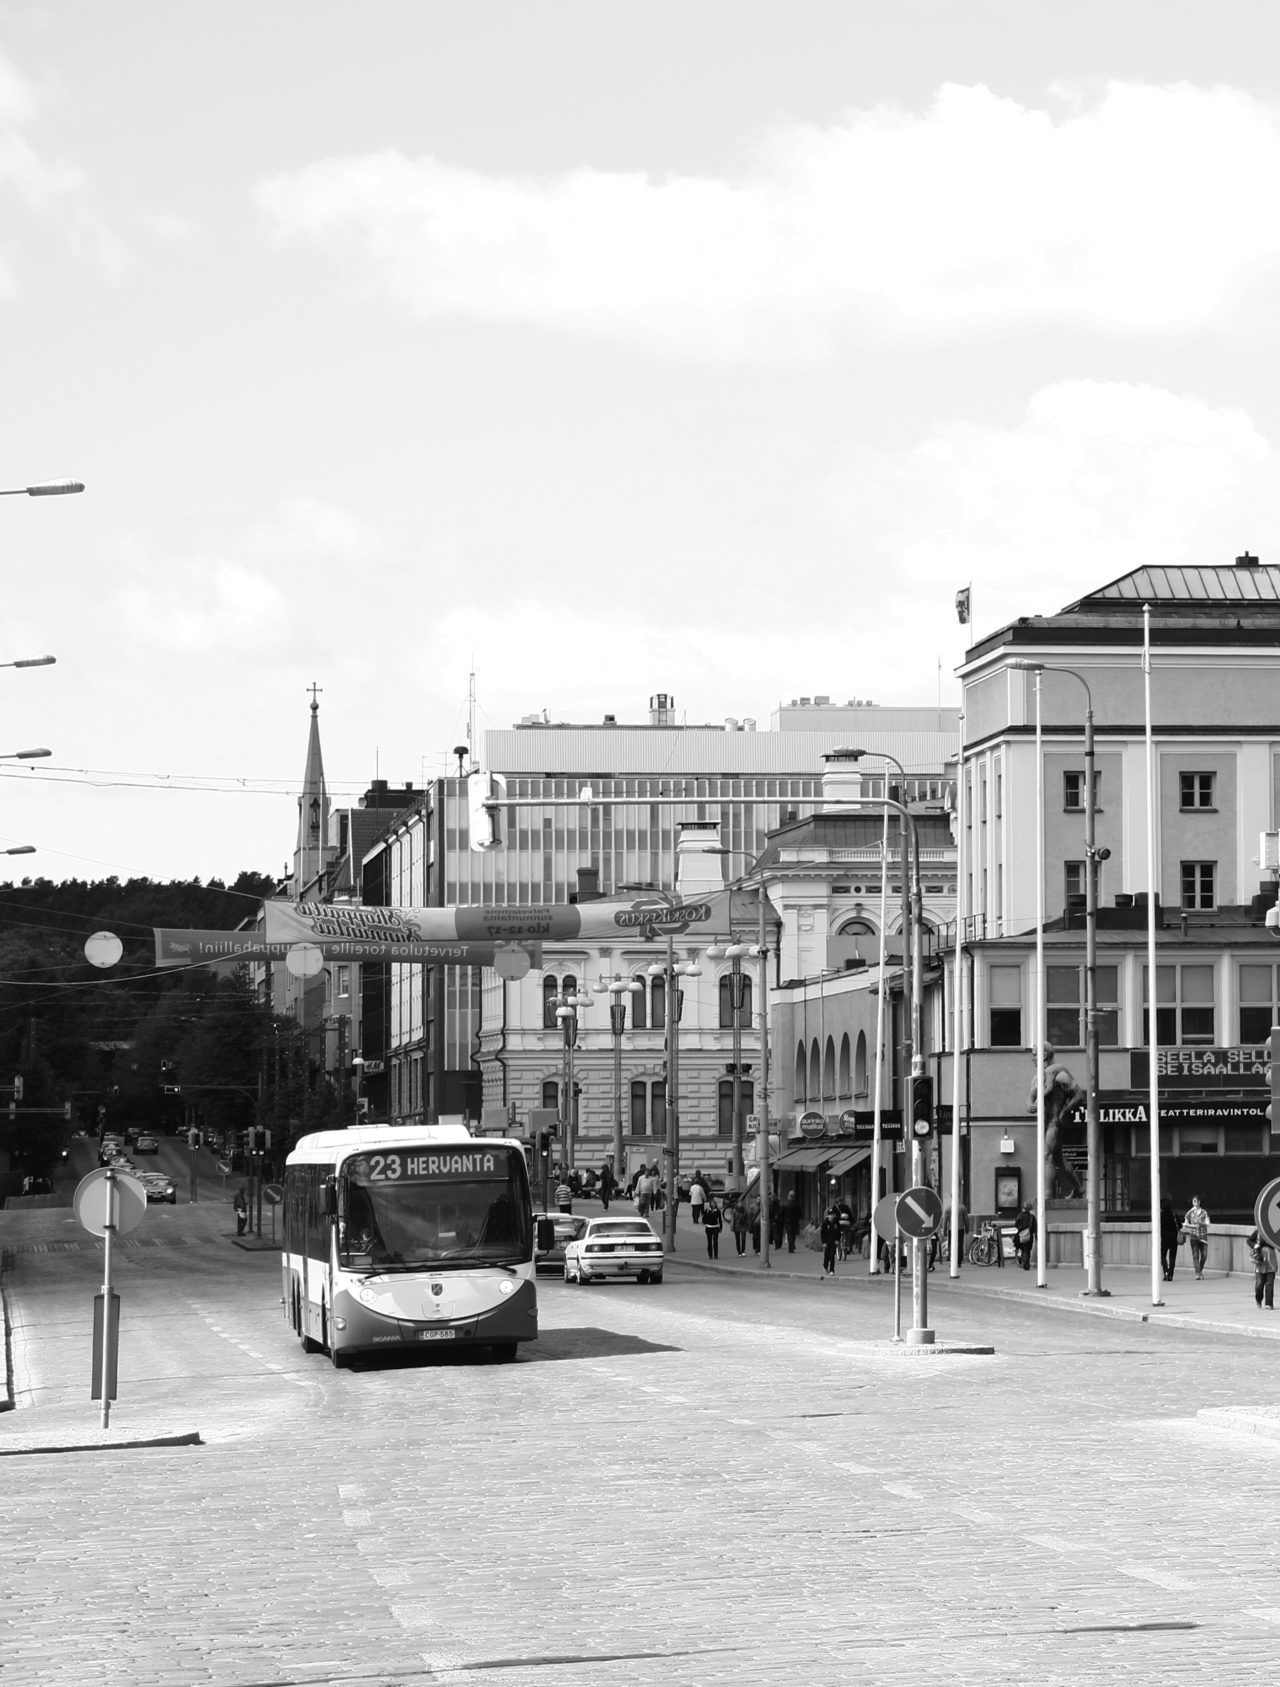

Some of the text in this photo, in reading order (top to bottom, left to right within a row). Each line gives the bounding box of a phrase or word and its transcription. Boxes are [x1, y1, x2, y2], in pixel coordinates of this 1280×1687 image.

[1157, 1051, 1215, 1063] SEELA
[369, 1153, 495, 1181] 23 HERVANTA
